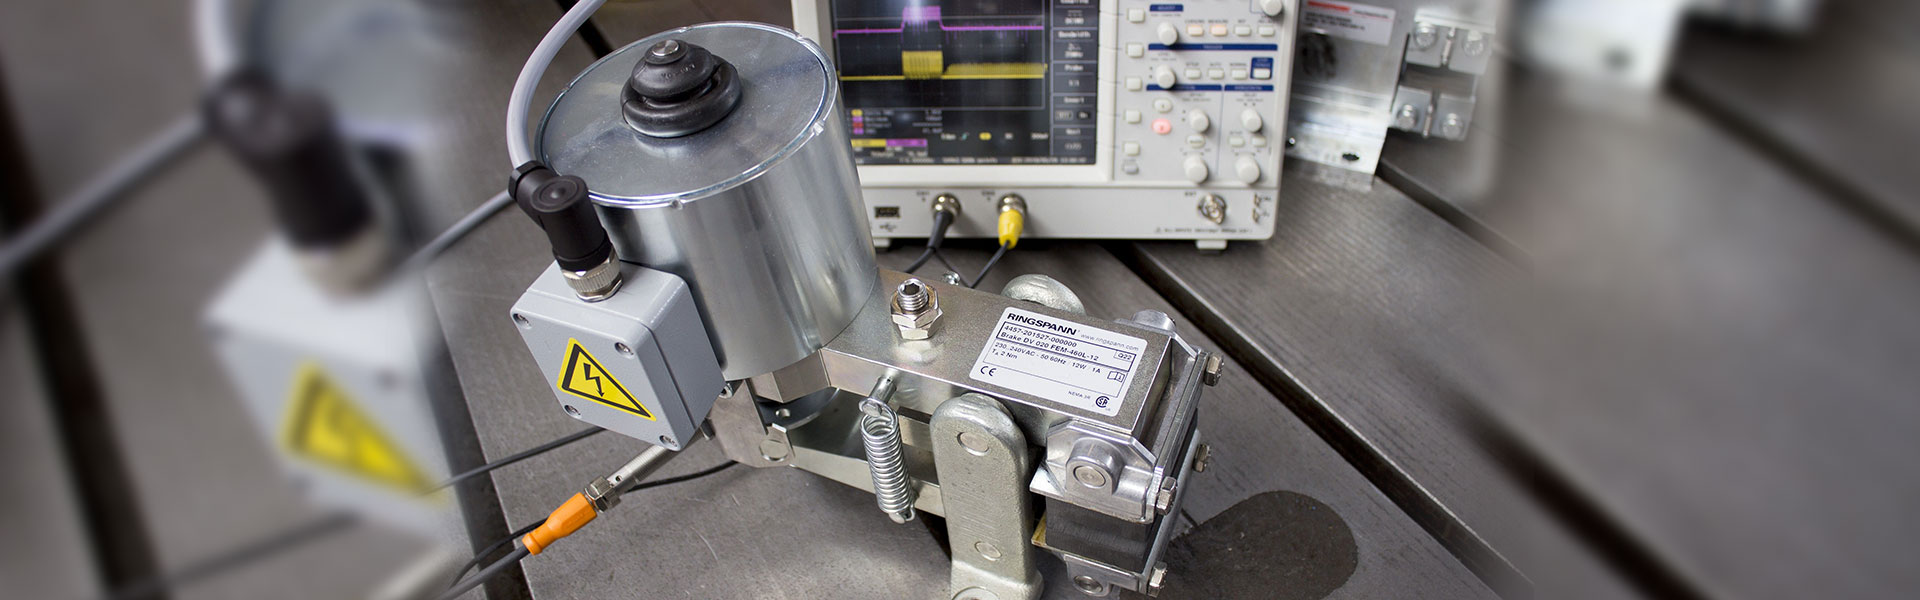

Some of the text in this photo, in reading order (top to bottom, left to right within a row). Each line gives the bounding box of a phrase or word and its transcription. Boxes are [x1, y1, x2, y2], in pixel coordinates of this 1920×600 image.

[1006, 312, 1077, 336] RINGSPANN
[1000, 331, 1022, 342] Brake
[1035, 340, 1049, 349] 020
[1003, 325, 1078, 348] 4457-201527-000000
[1080, 332, 1140, 351] www.ringspann.com
